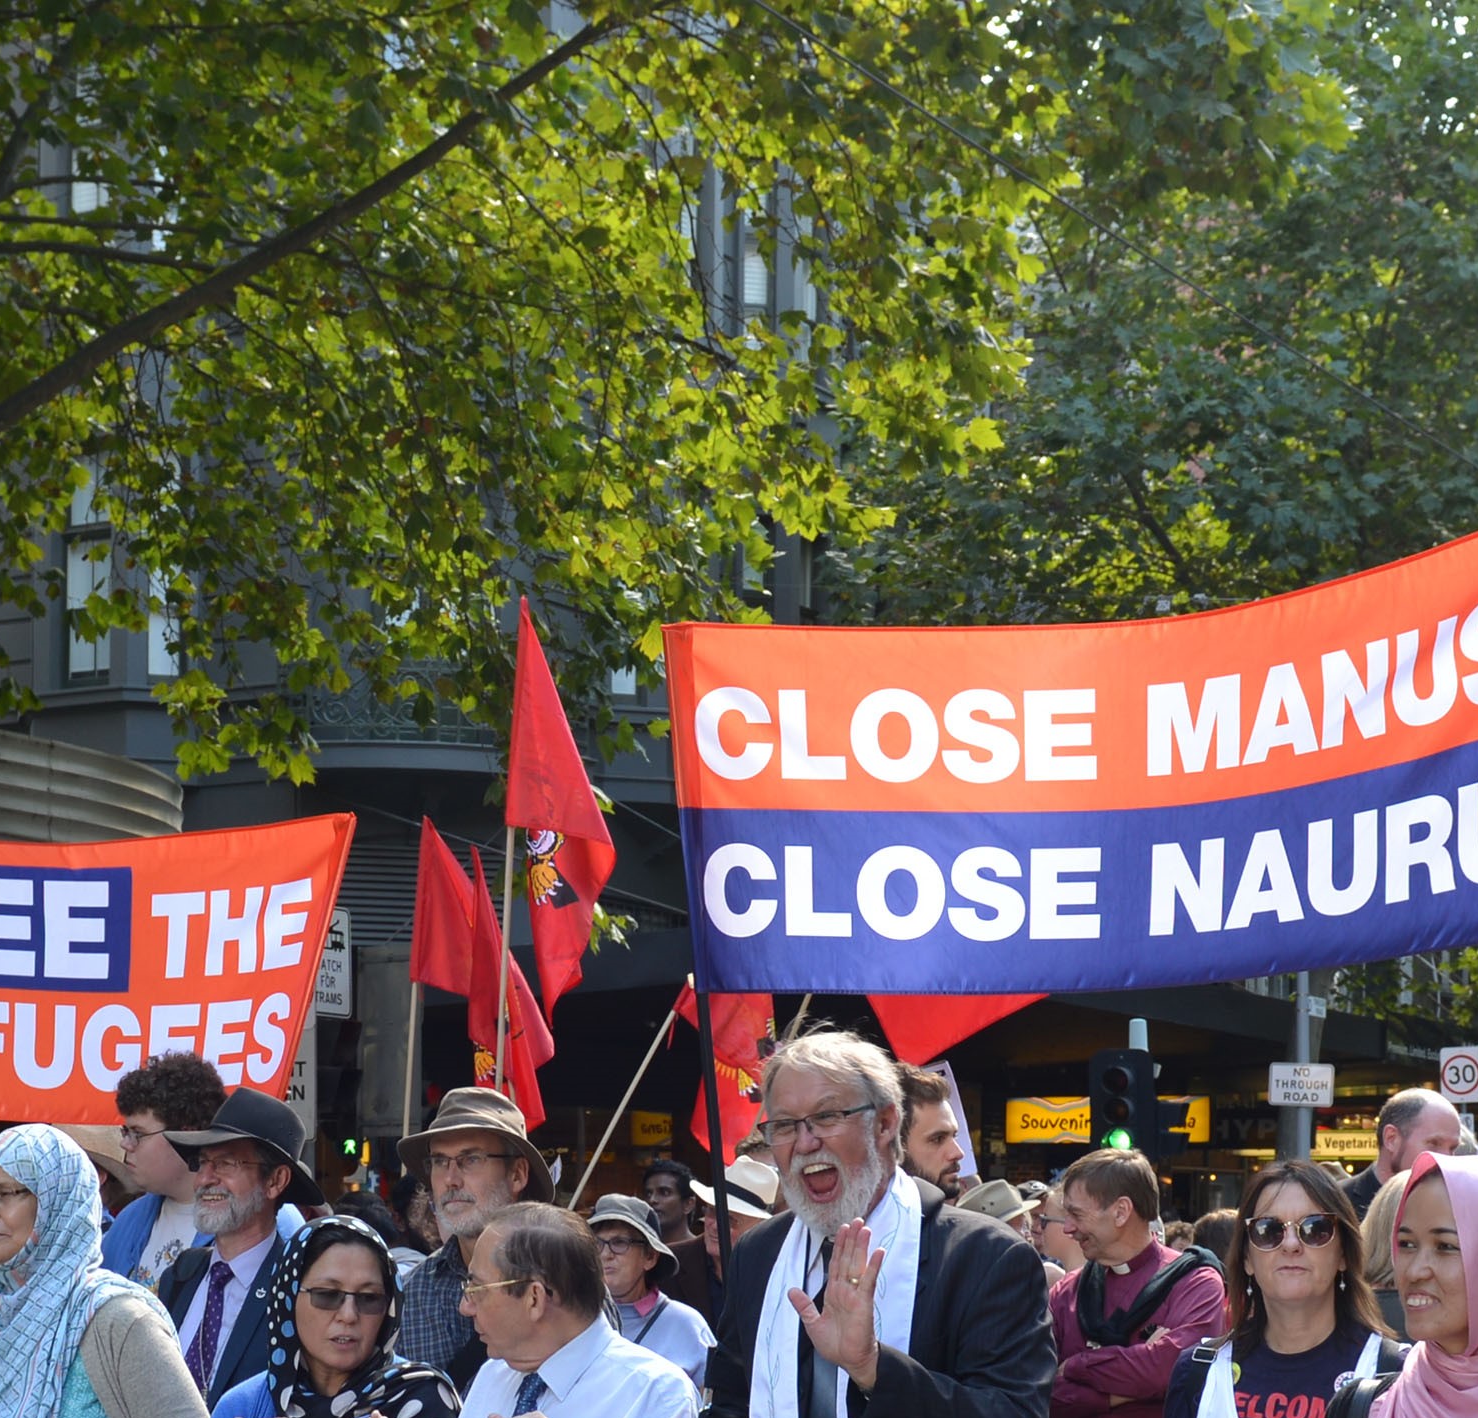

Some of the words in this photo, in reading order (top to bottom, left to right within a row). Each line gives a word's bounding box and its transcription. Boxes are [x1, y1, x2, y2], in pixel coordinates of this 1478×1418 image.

[694, 687, 1098, 783] CLOSE
[703, 843, 1102, 940] CLOSE
[151, 878, 312, 979] THE
[319, 960, 342, 973] ATCH
[320, 974, 336, 988] FOR
[1293, 1068, 1310, 1077] NO
[1448, 1064, 1476, 1085] 30
[1275, 1080, 1329, 1090] THROUGH
[1283, 1092, 1319, 1102] ROAD
[1324, 1137, 1378, 1152] Vegetaria
